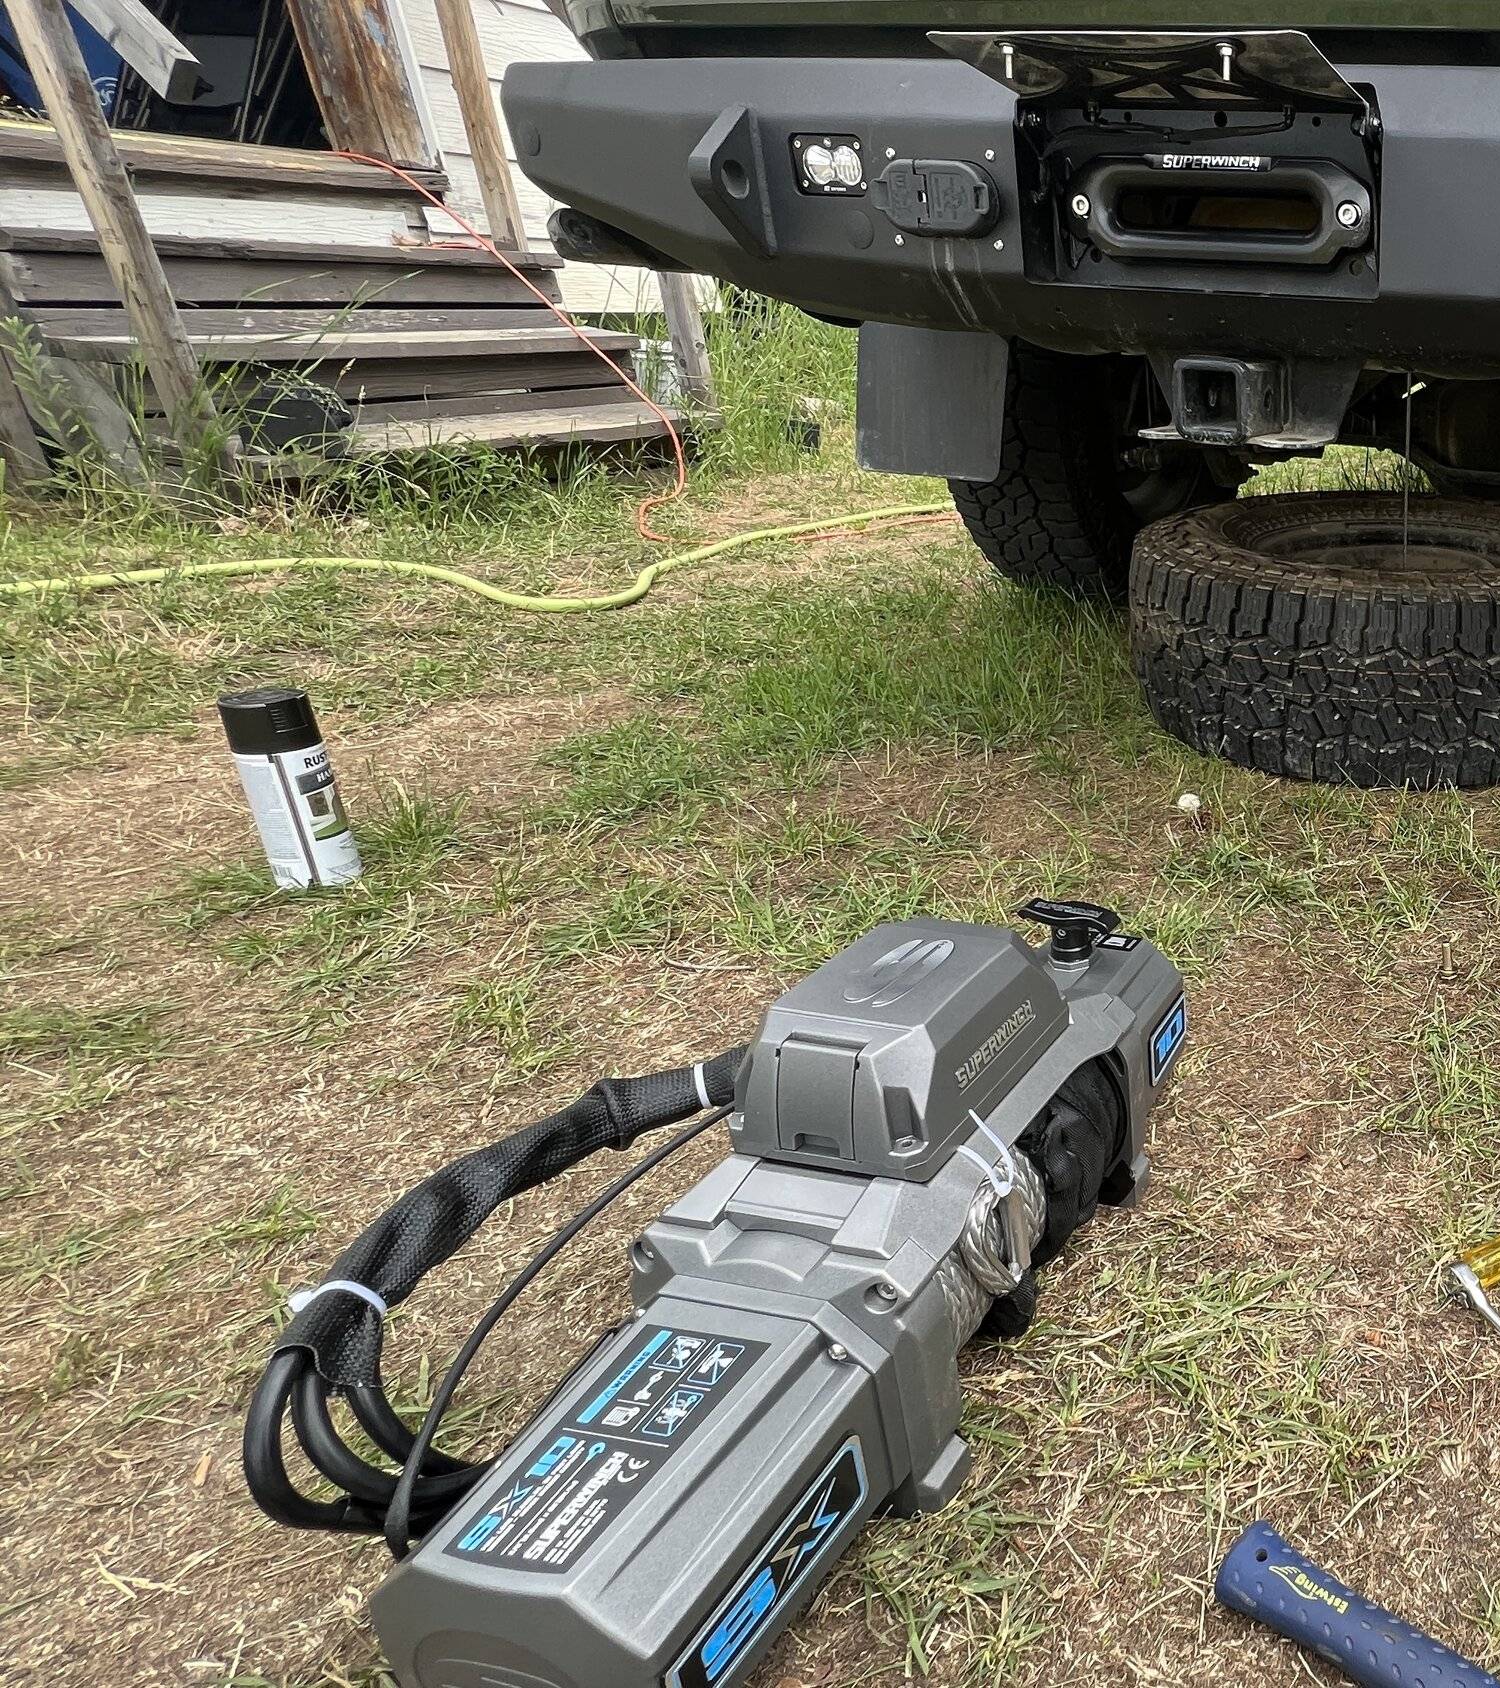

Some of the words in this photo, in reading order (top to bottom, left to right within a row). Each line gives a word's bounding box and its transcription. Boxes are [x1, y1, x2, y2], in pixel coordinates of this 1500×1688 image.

[1162, 154, 1260, 171] SUPERWINCH
[954, 999, 1034, 1090] SUPERWINCH
[1156, 1008, 1183, 1064] 10
[522, 1451, 630, 1560] SUPERWINCH
[700, 1476, 840, 1682] SX
[1294, 1573, 1349, 1615] Estwing
